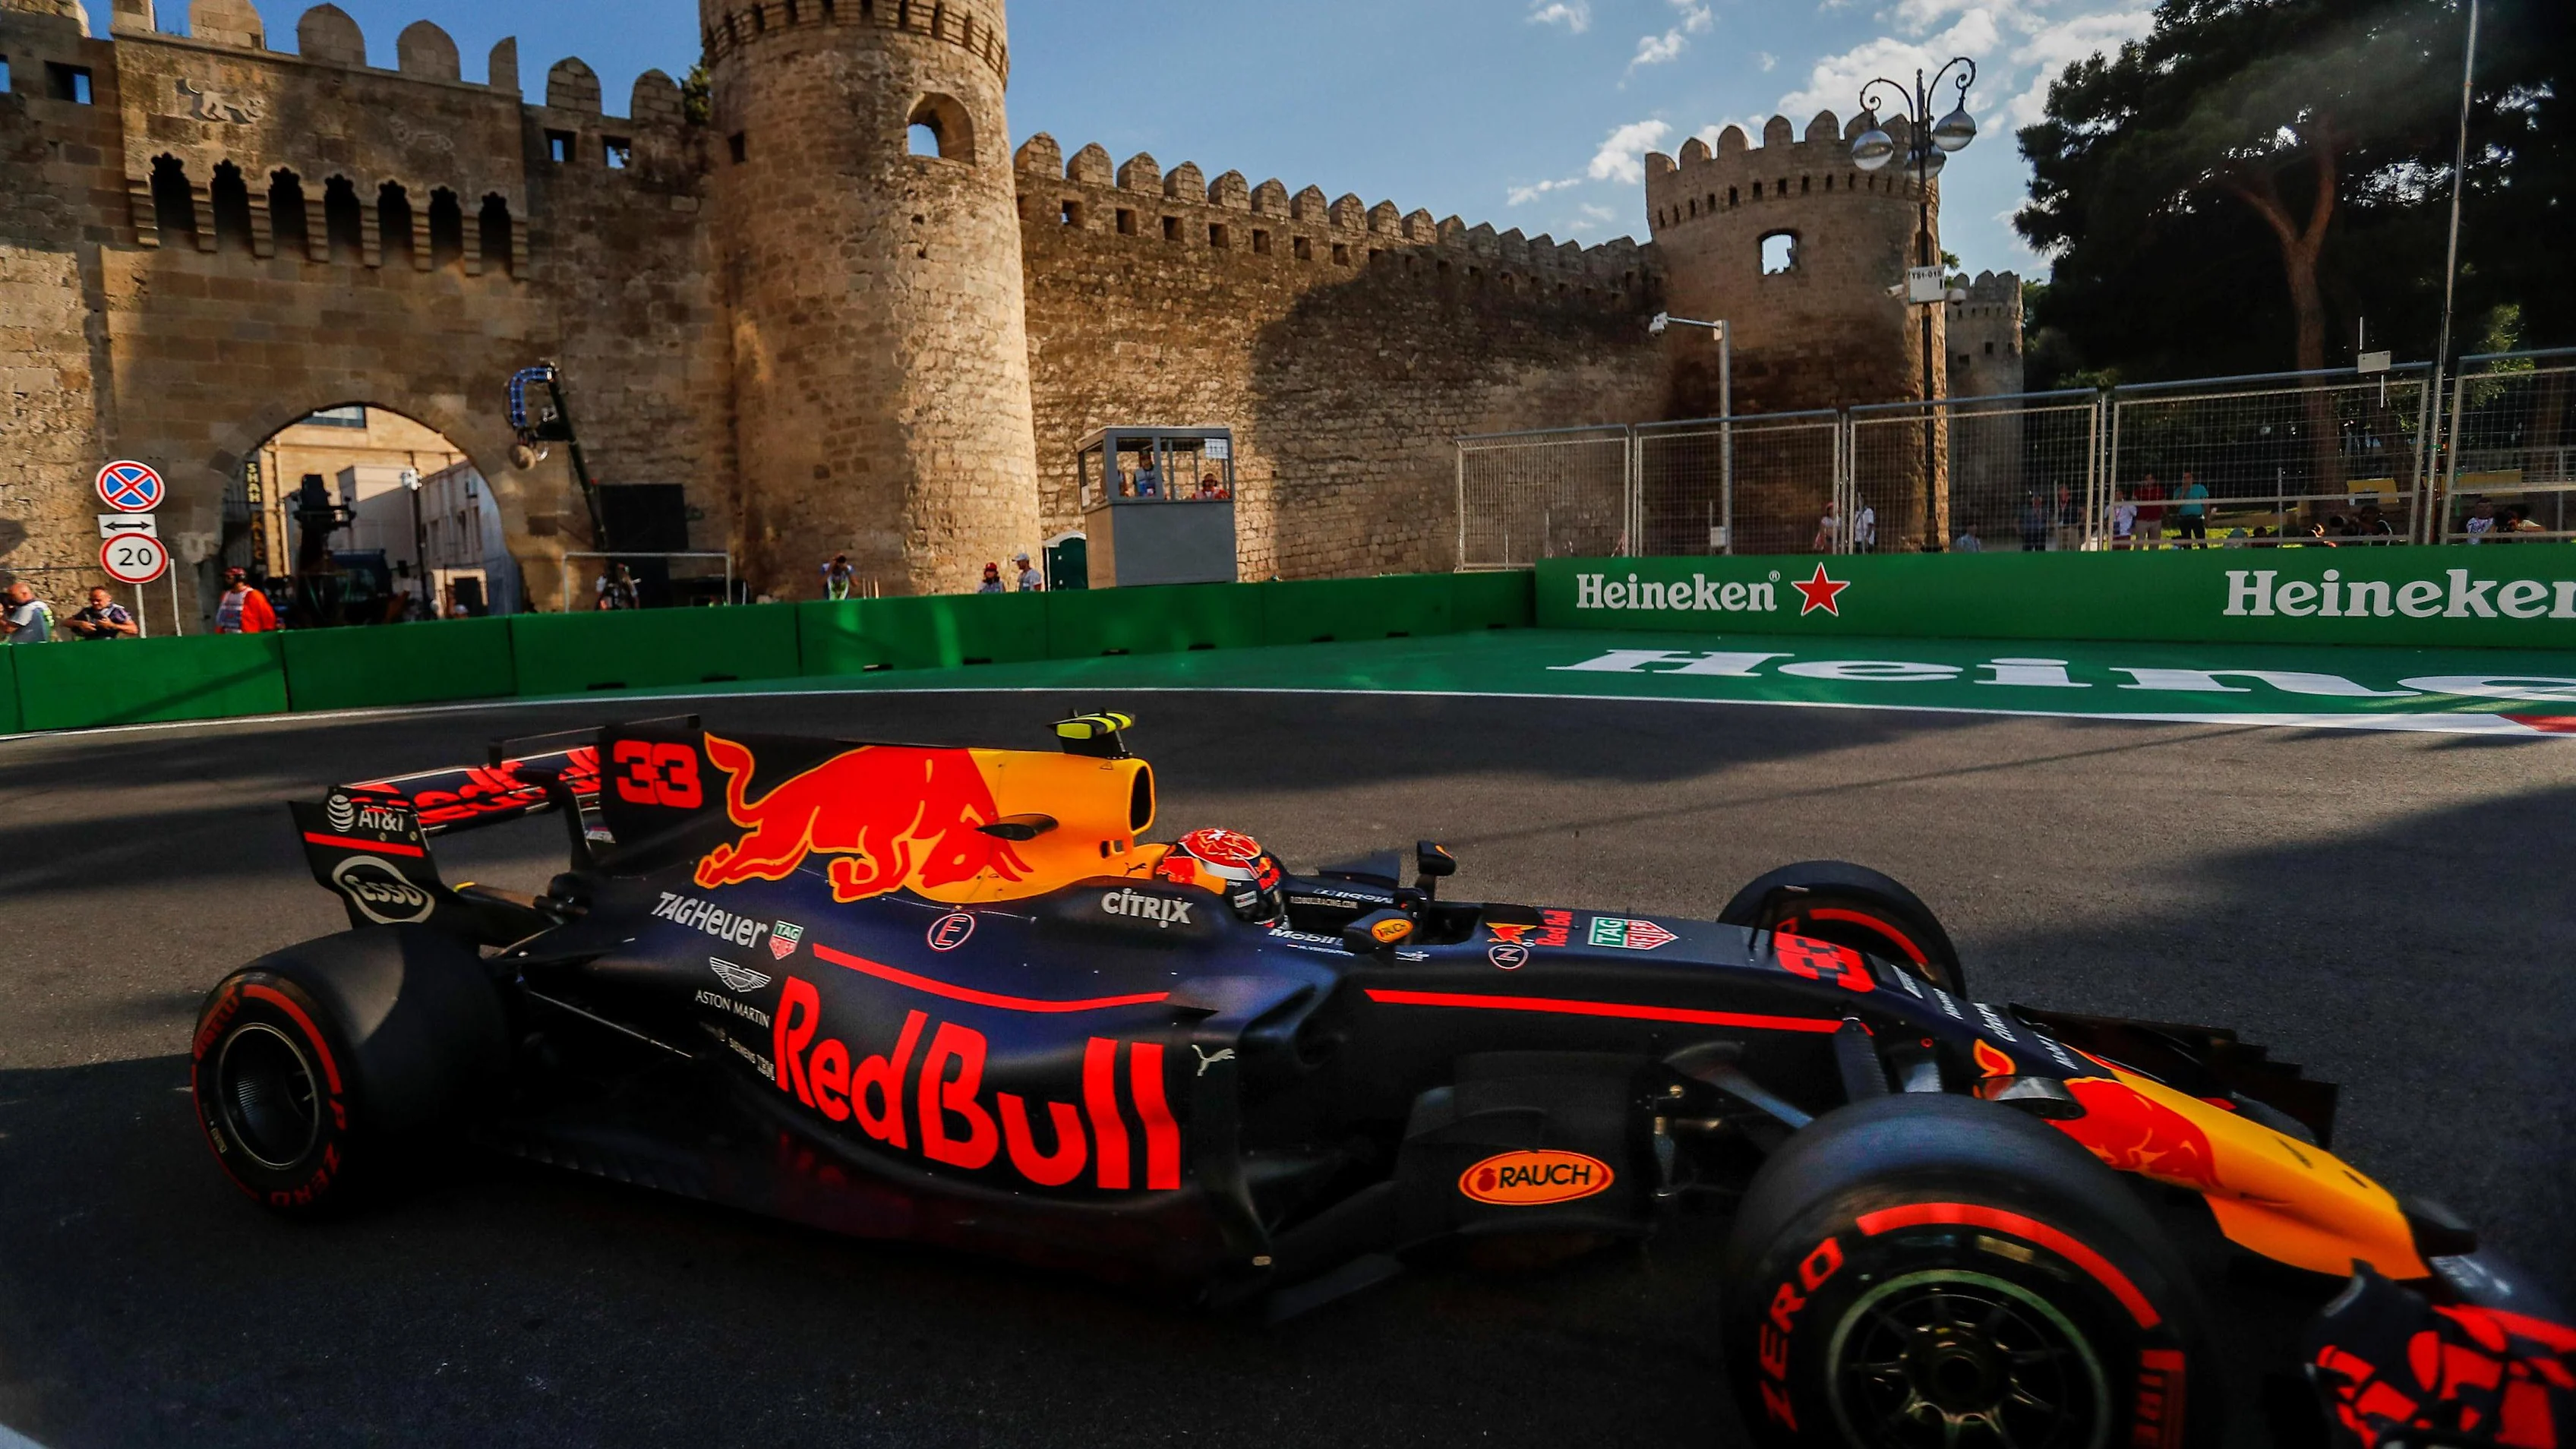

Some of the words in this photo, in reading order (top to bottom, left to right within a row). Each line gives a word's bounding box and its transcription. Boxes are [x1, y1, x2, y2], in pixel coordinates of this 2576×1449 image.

[118, 548, 152, 566] 20
[614, 739, 703, 809] 33
[358, 810, 405, 832] AT&T
[778, 923, 800, 940] TAG
[935, 916, 968, 945] E
[1267, 928, 1337, 944] Mobil
[1596, 920, 1624, 943] TAG
[695, 990, 731, 1012] ASTON
[733, 1001, 770, 1029] MARTIN
[270, 1142, 341, 1207] ZERO
[1499, 1163, 1591, 1189] RAUCH
[1759, 1237, 1843, 1433] ZERO
